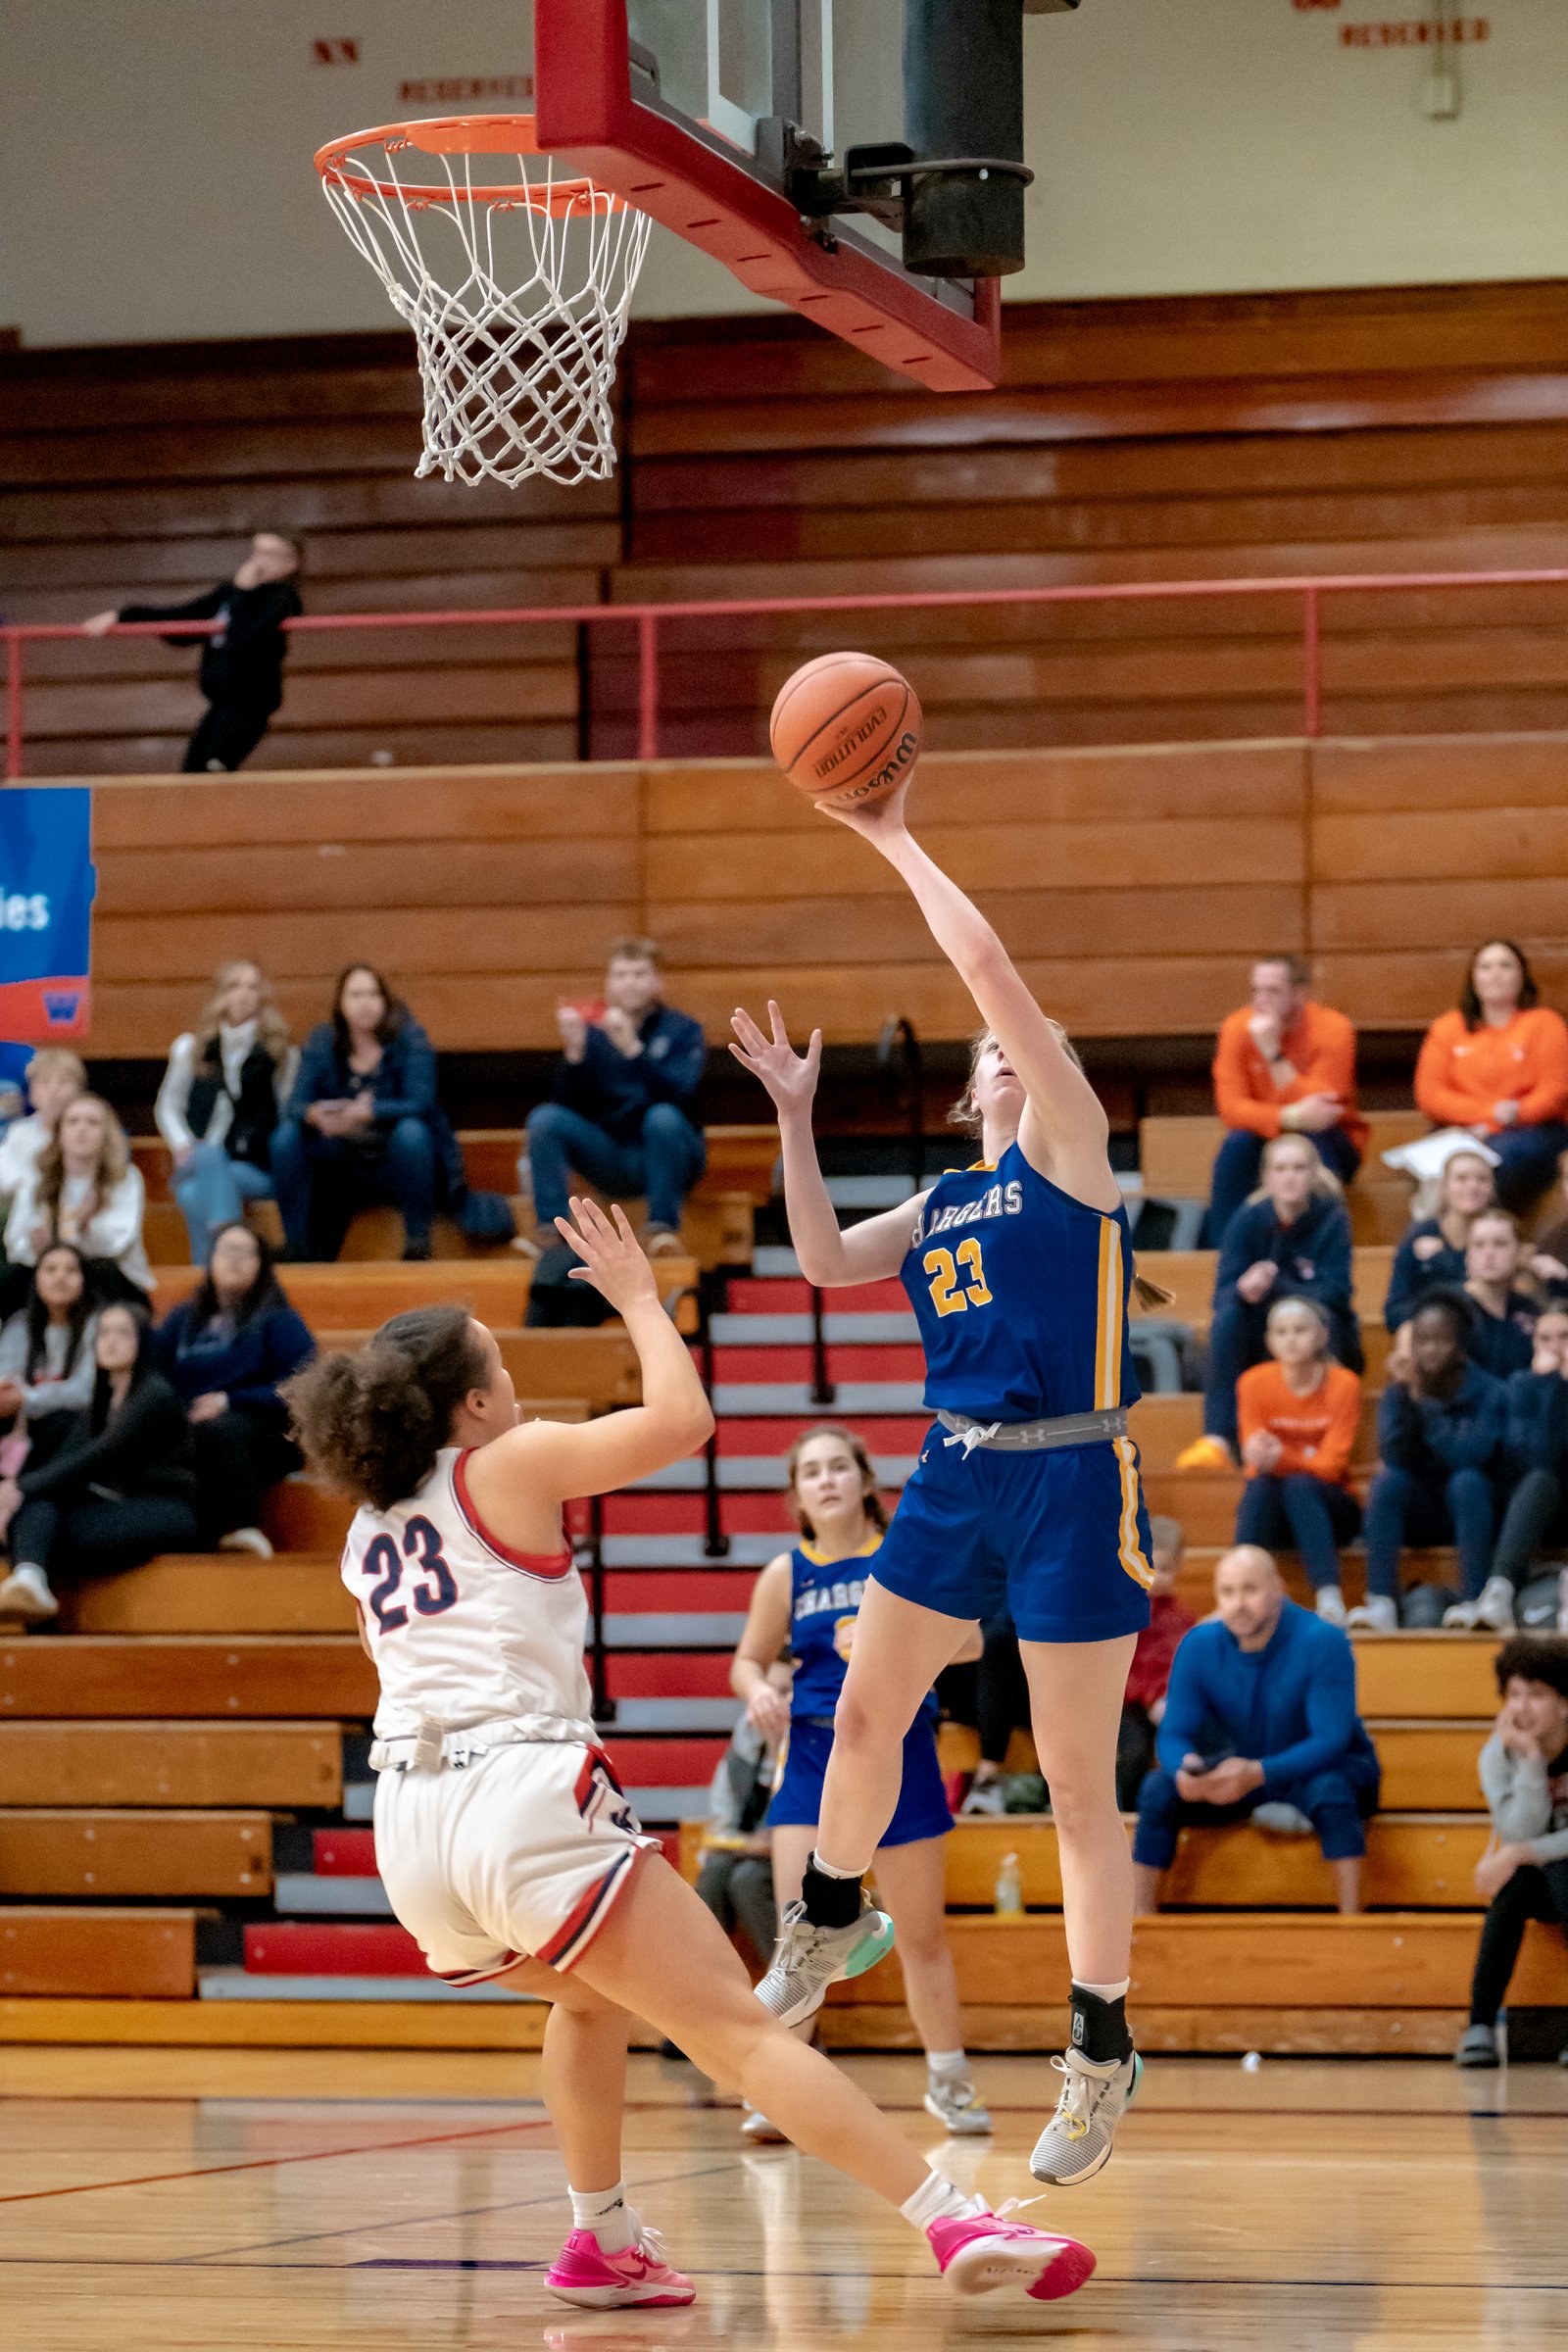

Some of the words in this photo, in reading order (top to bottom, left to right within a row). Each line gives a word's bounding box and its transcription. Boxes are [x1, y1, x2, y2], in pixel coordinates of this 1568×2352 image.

[814, 705, 888, 779] EVOLUTION
[922, 1237, 994, 1318] 23
[361, 1513, 459, 1638] 23
